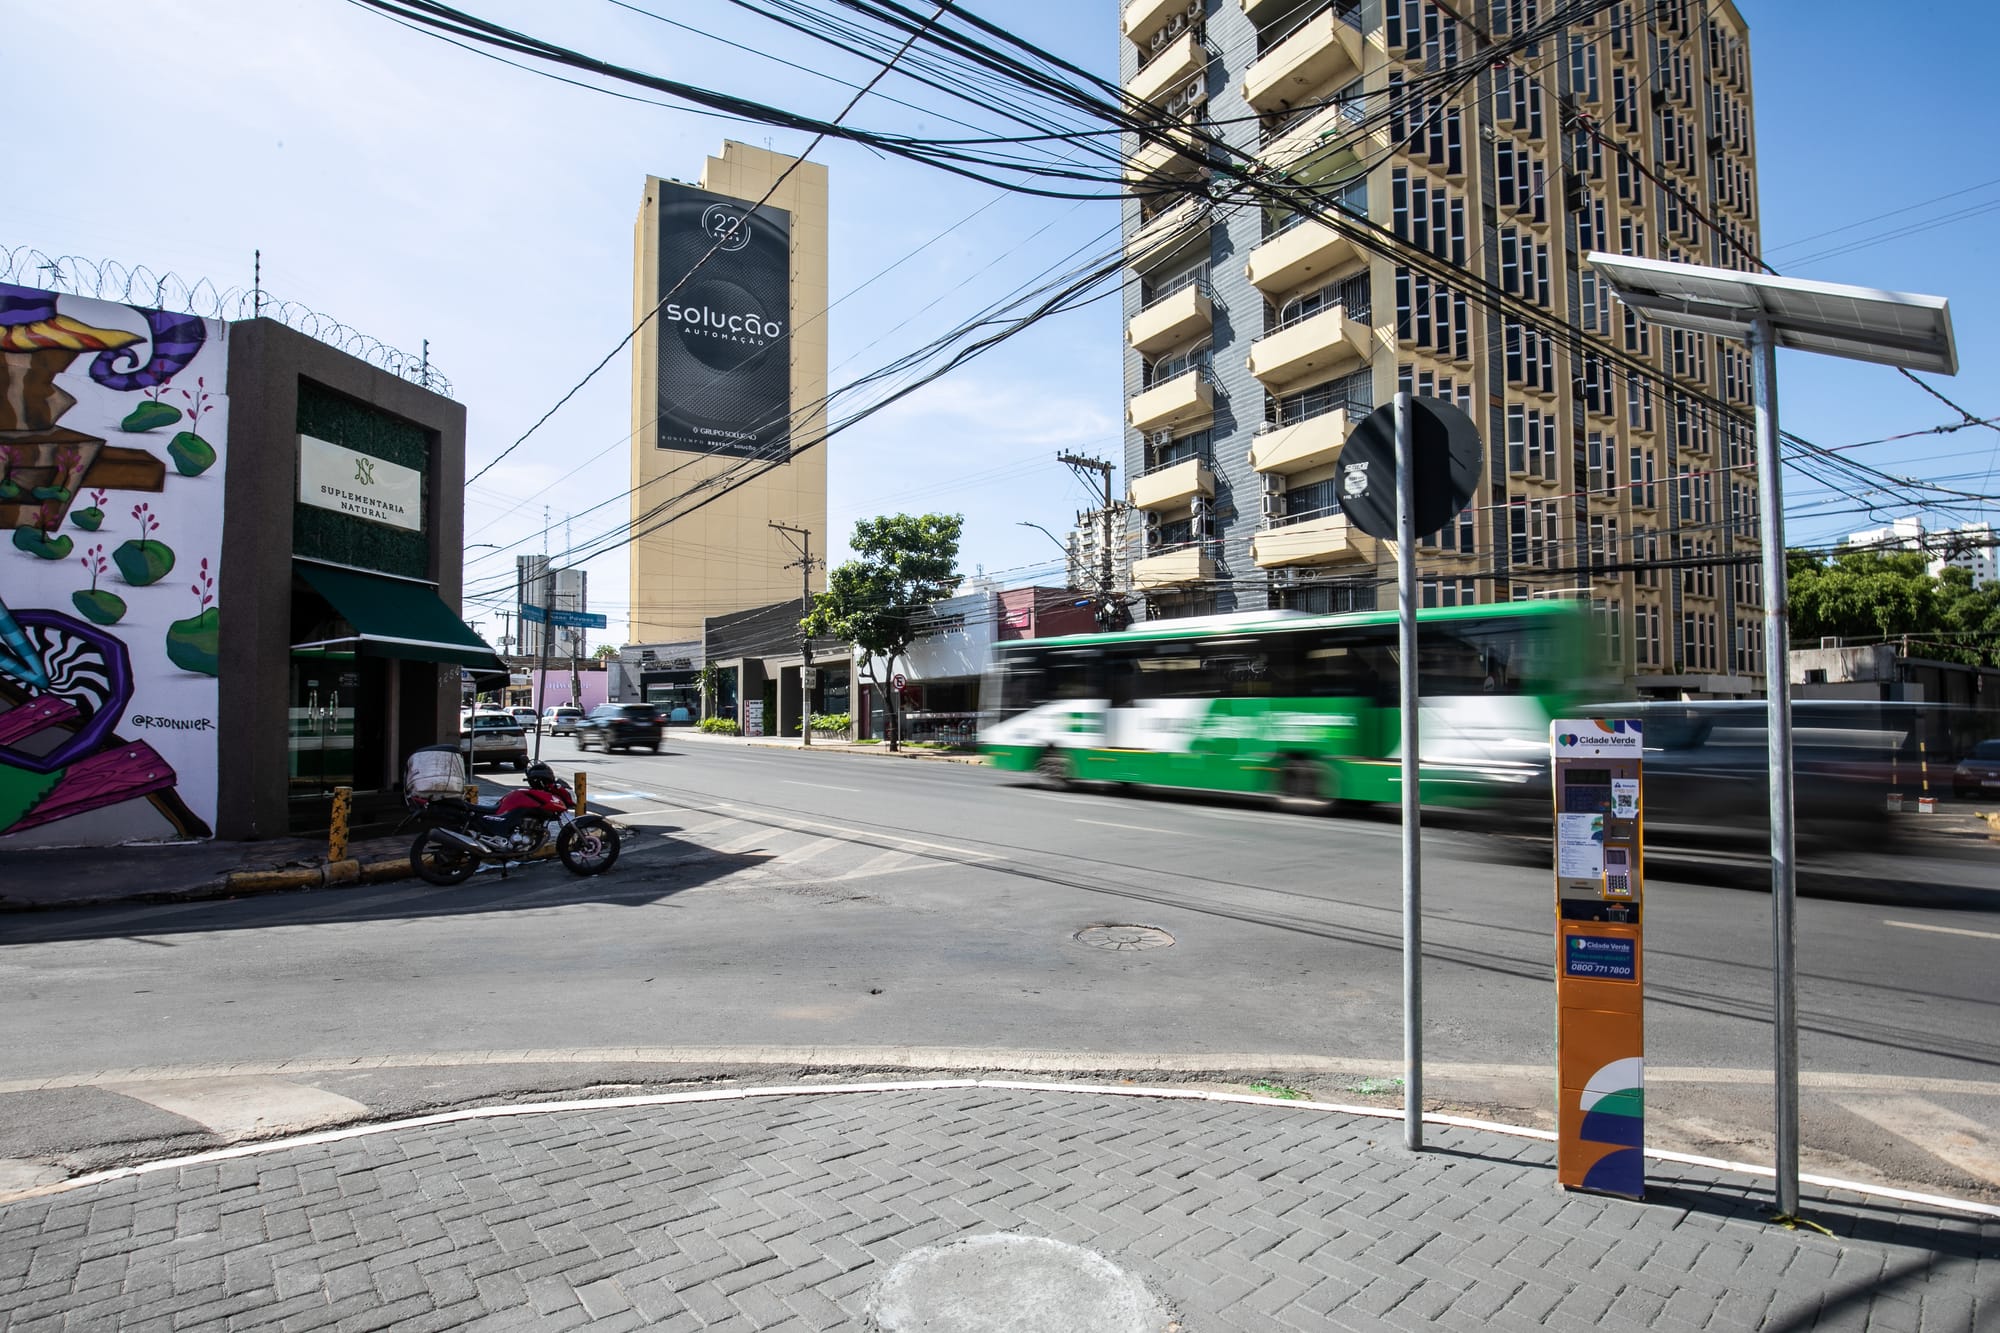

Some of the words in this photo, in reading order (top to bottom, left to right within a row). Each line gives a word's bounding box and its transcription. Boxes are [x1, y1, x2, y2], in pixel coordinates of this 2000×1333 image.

[714, 213, 739, 235] 22
[699, 427, 725, 437] GRUPO
[320, 485, 405, 514] SUPLEMENTARIA
[340, 501, 387, 520] NATURAL
[1579, 736, 1609, 744] Cidade
[1610, 736, 1636, 744] Verde
[1586, 941, 1610, 950] Cidade
[1610, 943, 1630, 951] Verde
[1571, 963, 1593, 972] 0800
[1594, 965, 1608, 973] 771
[1609, 966, 1631, 974] 7800
